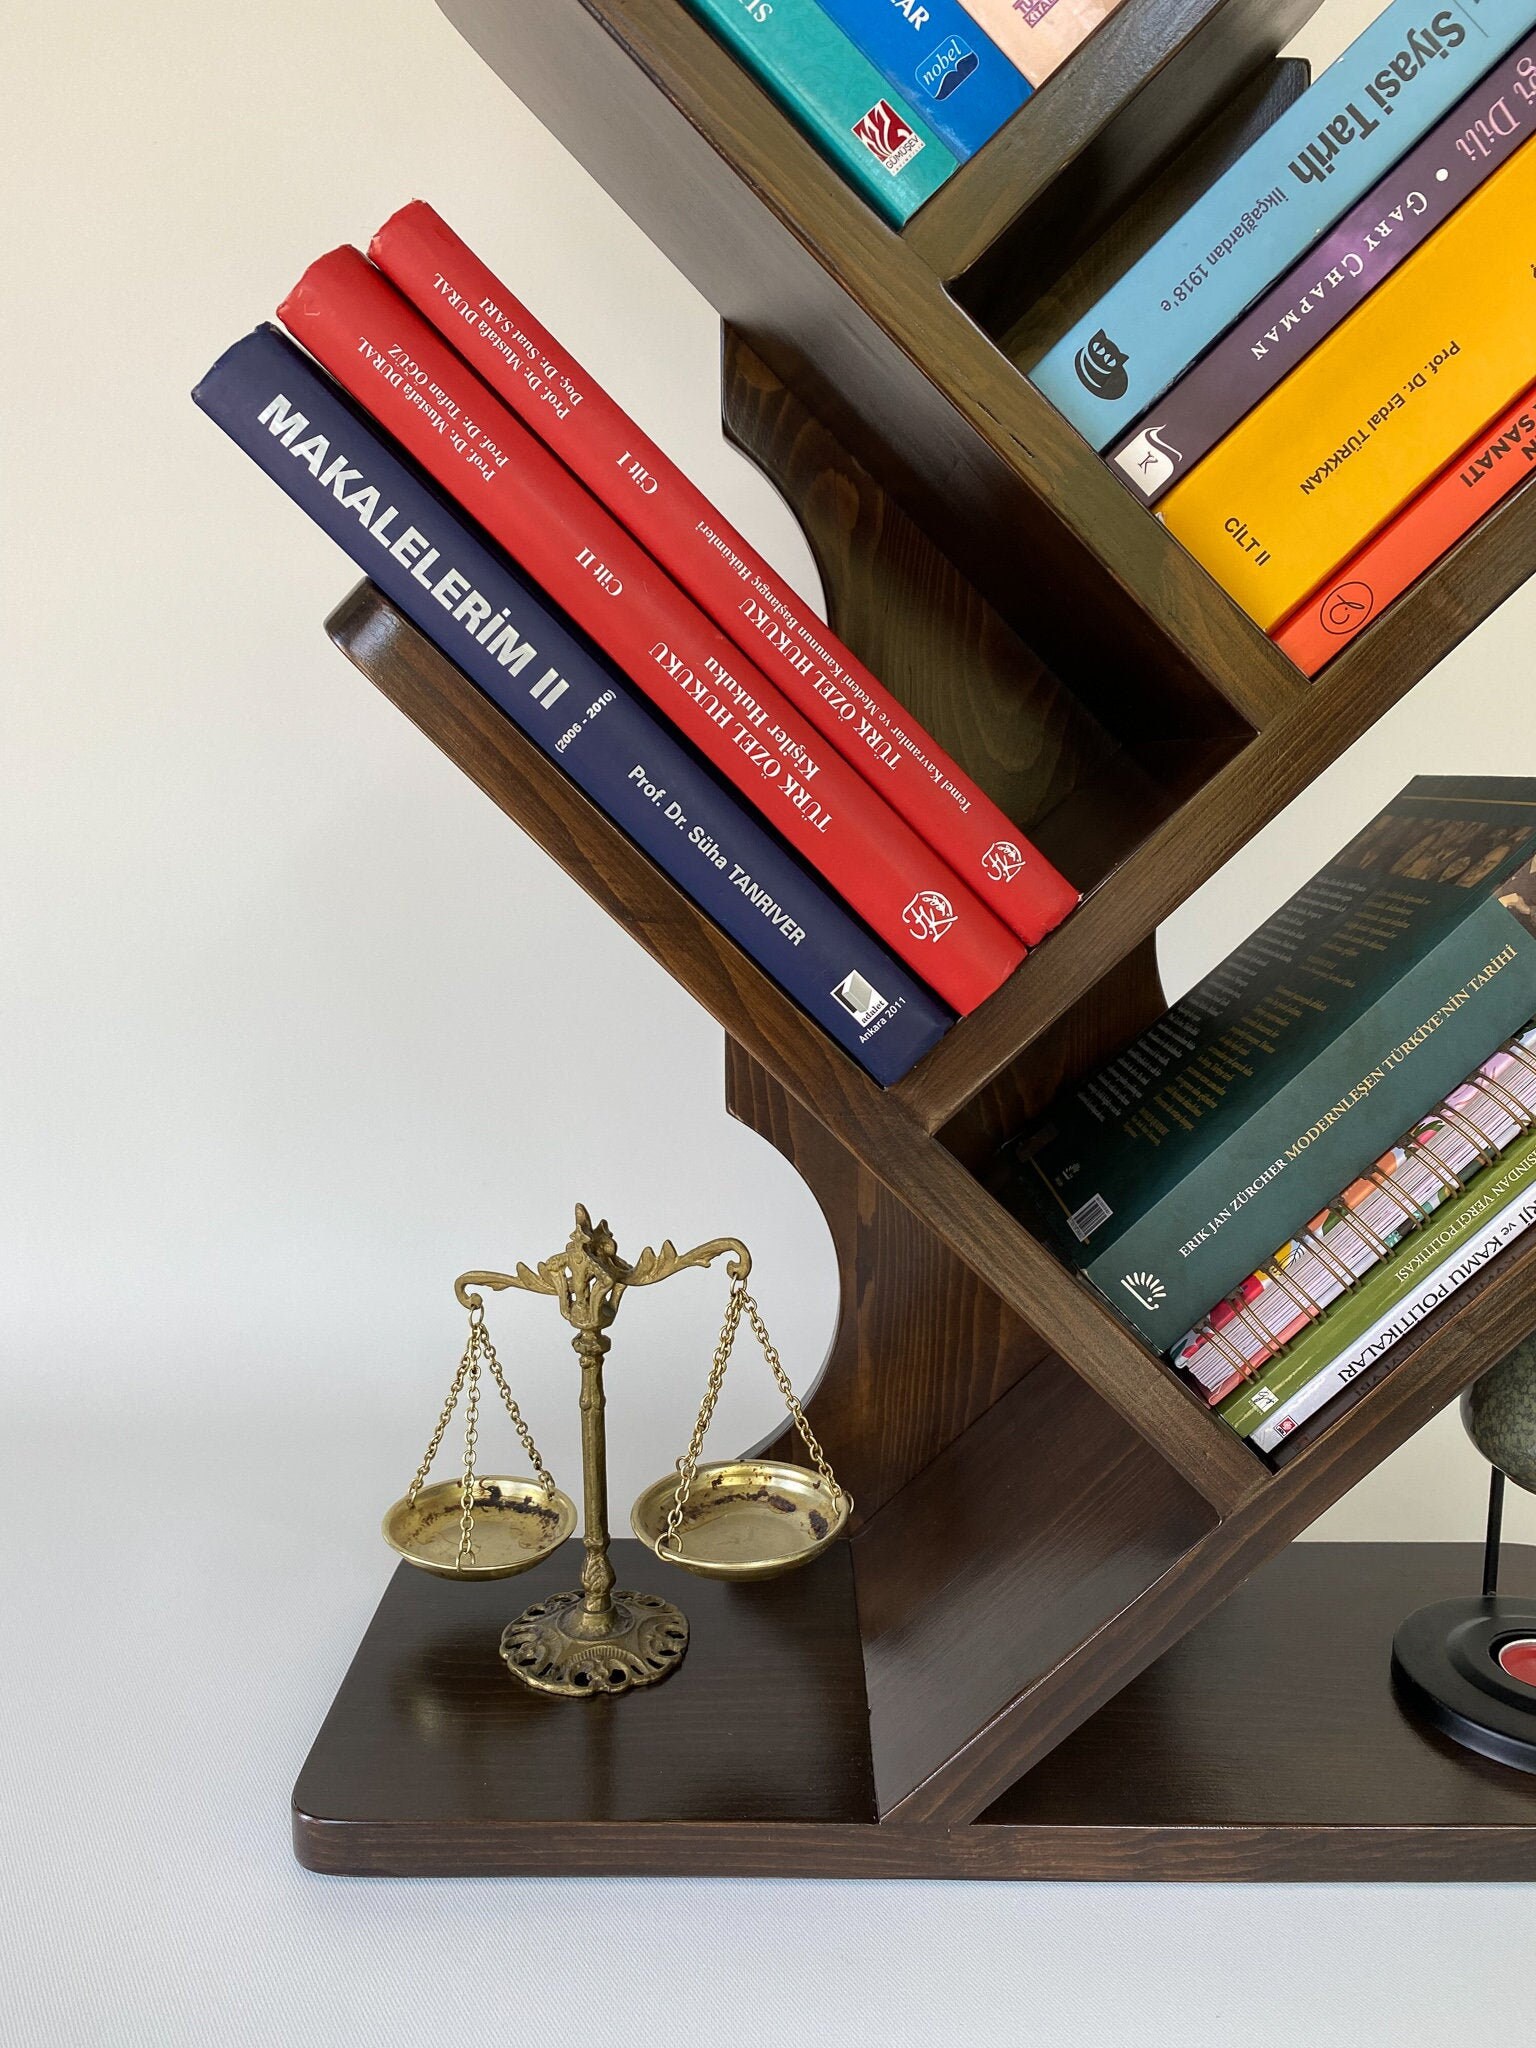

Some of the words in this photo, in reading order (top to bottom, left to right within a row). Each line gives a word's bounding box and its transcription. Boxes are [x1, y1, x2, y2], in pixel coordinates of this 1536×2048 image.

[738, 0, 774, 23] IS
[890, 0, 930, 32] AR
[923, 38, 964, 86] nobel
[1365, 10, 1466, 116] Siyasi
[885, 135, 920, 170] GÜMÜŞEV
[1287, 101, 1381, 186] Tarih
[1456, 96, 1520, 161] Dili
[1362, 190, 1428, 255] GARY
[432, 272, 479, 325] DURAL
[1161, 261, 1209, 313] 1918'e
[1249, 251, 1365, 361] CHAPMAN
[478, 297, 515, 334] SARI
[357, 336, 404, 389] DURAL
[478, 320, 524, 371] Mustafa
[511, 328, 540, 360] Suat
[540, 356, 559, 380] Dr.
[1424, 340, 1461, 375] Prof.
[428, 381, 461, 419] Tufan
[523, 366, 543, 391] Dr.
[540, 385, 571, 421] Prof.
[558, 375, 584, 407] Doç.
[1402, 372, 1427, 393] Dr.
[402, 383, 449, 435] Mustafa
[462, 415, 481, 439] Dr.
[1366, 393, 1407, 432] Erdal
[449, 428, 468, 455] Dr.
[465, 447, 497, 483] Prof.
[479, 434, 511, 469] Prof.
[615, 450, 632, 468] I
[1299, 430, 1371, 496] TÜRKKAN
[1460, 414, 1535, 488] SANATI
[629, 462, 659, 495] Cilt
[256, 393, 538, 678] MAKALELERİM
[529, 667, 570, 711] II
[575, 546, 597, 569] II
[694, 520, 752, 582] Hükümleri
[1223, 516, 1260, 555] CİLT
[1255, 551, 1272, 567] II
[592, 562, 624, 597] Cilt
[750, 575, 799, 631] Başlangıç
[738, 598, 815, 678] HUKUKU
[798, 625, 846, 679] Kanunun
[648, 642, 735, 729] HUKUKU
[703, 655, 770, 729] Hukuku
[812, 669, 857, 722] ÖZEL
[554, 722, 583, 754] (2006
[585, 689, 617, 720] 2010)
[853, 716, 902, 772] TÜRK
[877, 712, 893, 726] ve
[731, 722, 781, 780] ÖZEL
[766, 724, 821, 782] Kişiler
[890, 721, 944, 786] Kavramlar
[777, 773, 833, 833] TÜRK
[941, 780, 972, 815] Temel
[627, 764, 666, 807] Prof.
[663, 801, 688, 831] Dr.
[687, 825, 728, 870] Süha
[727, 863, 808, 947] TANRIVER
[858, 1016, 887, 1044] Ankara
[884, 996, 907, 1020] 2011
[861, 999, 886, 1025] adalet
[1178, 1226, 1210, 1258] ERIK
[1209, 1208, 1231, 1236] JAN
[1229, 1157, 1288, 1213] ZÜRCHER
[1283, 1067, 1388, 1161] MODERNLEŞEN
[1466, 943, 1518, 999] TARİHİ
[1455, 1194, 1495, 1230] VERGİ
[1500, 1222, 1517, 1236] ve
[1394, 1226, 1459, 1284] POLİTİKASI
[1448, 1236, 1504, 1287] KAMU
[1337, 1283, 1450, 1385] POLİTİKALARI
